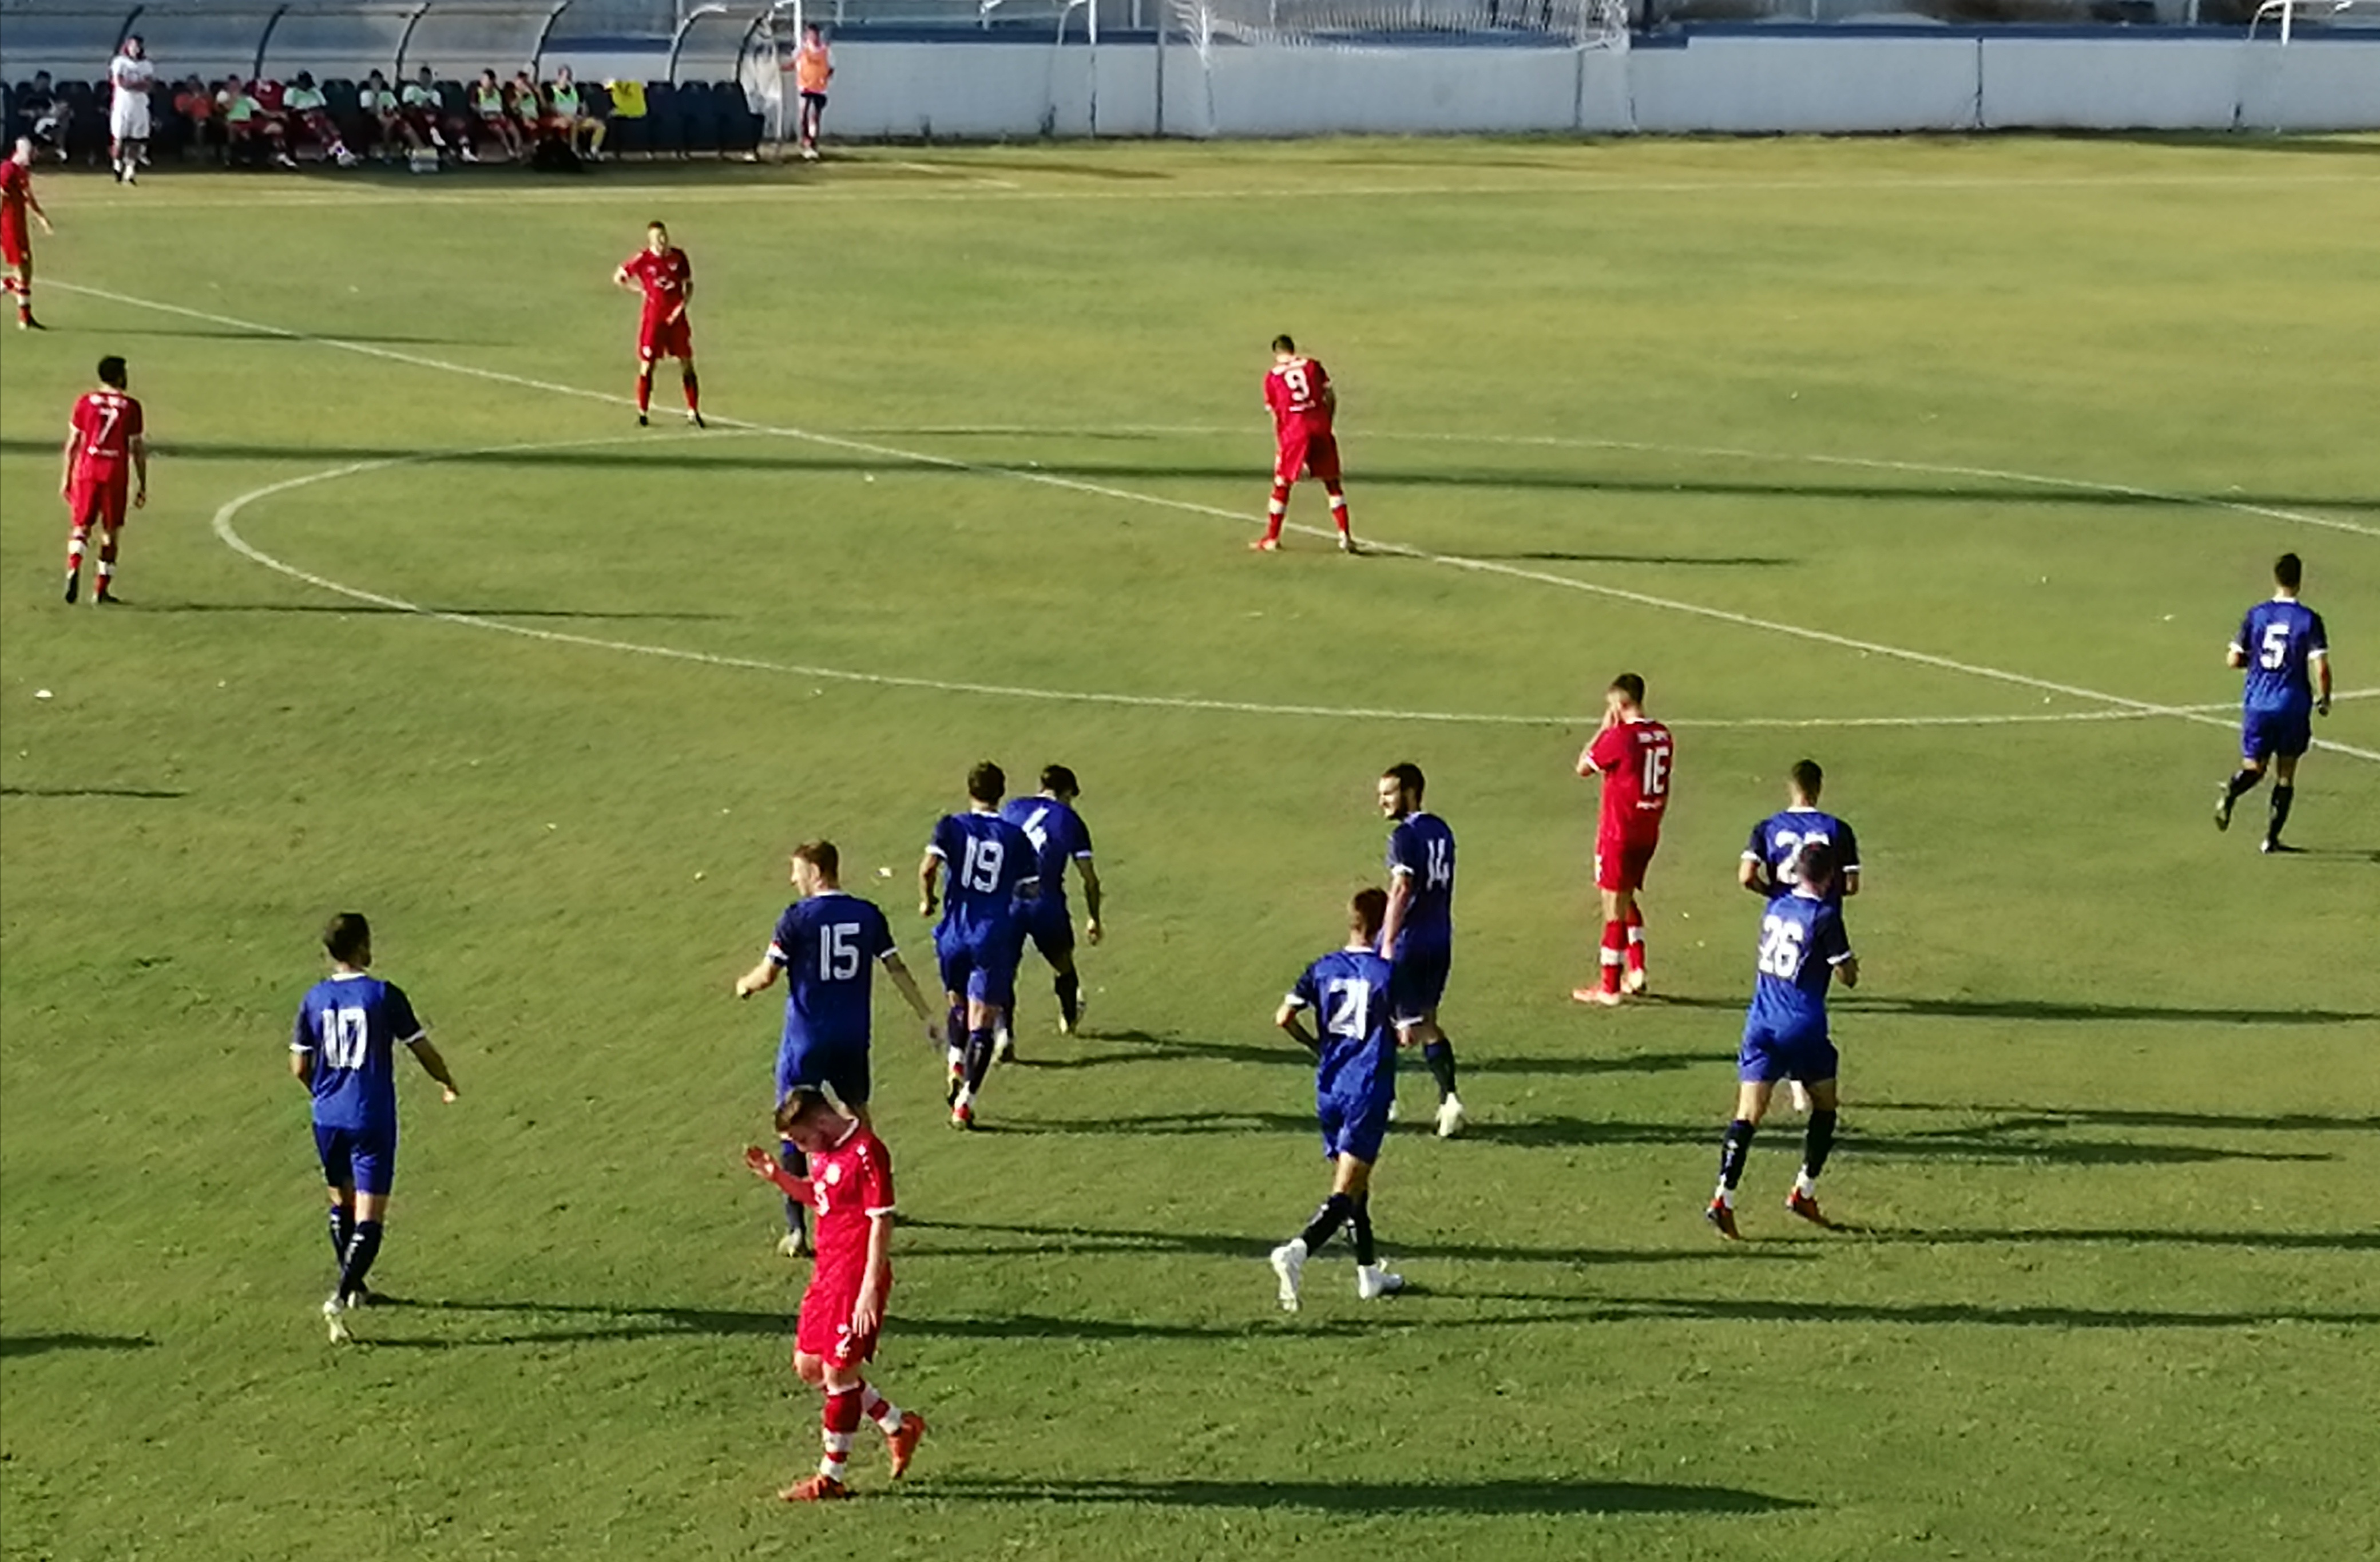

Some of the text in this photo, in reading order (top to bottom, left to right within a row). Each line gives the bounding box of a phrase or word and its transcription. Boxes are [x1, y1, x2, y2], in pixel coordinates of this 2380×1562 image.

[1284, 368, 1310, 401] 9
[99, 408, 118, 445] 7
[2260, 624, 2289, 669] 5
[962, 835, 1003, 893] 19
[1427, 838, 1450, 890] 14
[1775, 831, 1830, 885] 2
[820, 922, 860, 981] 15
[1758, 915, 1803, 977] 26
[1328, 978, 1370, 1040] 21
[322, 1009, 367, 1069] 10
